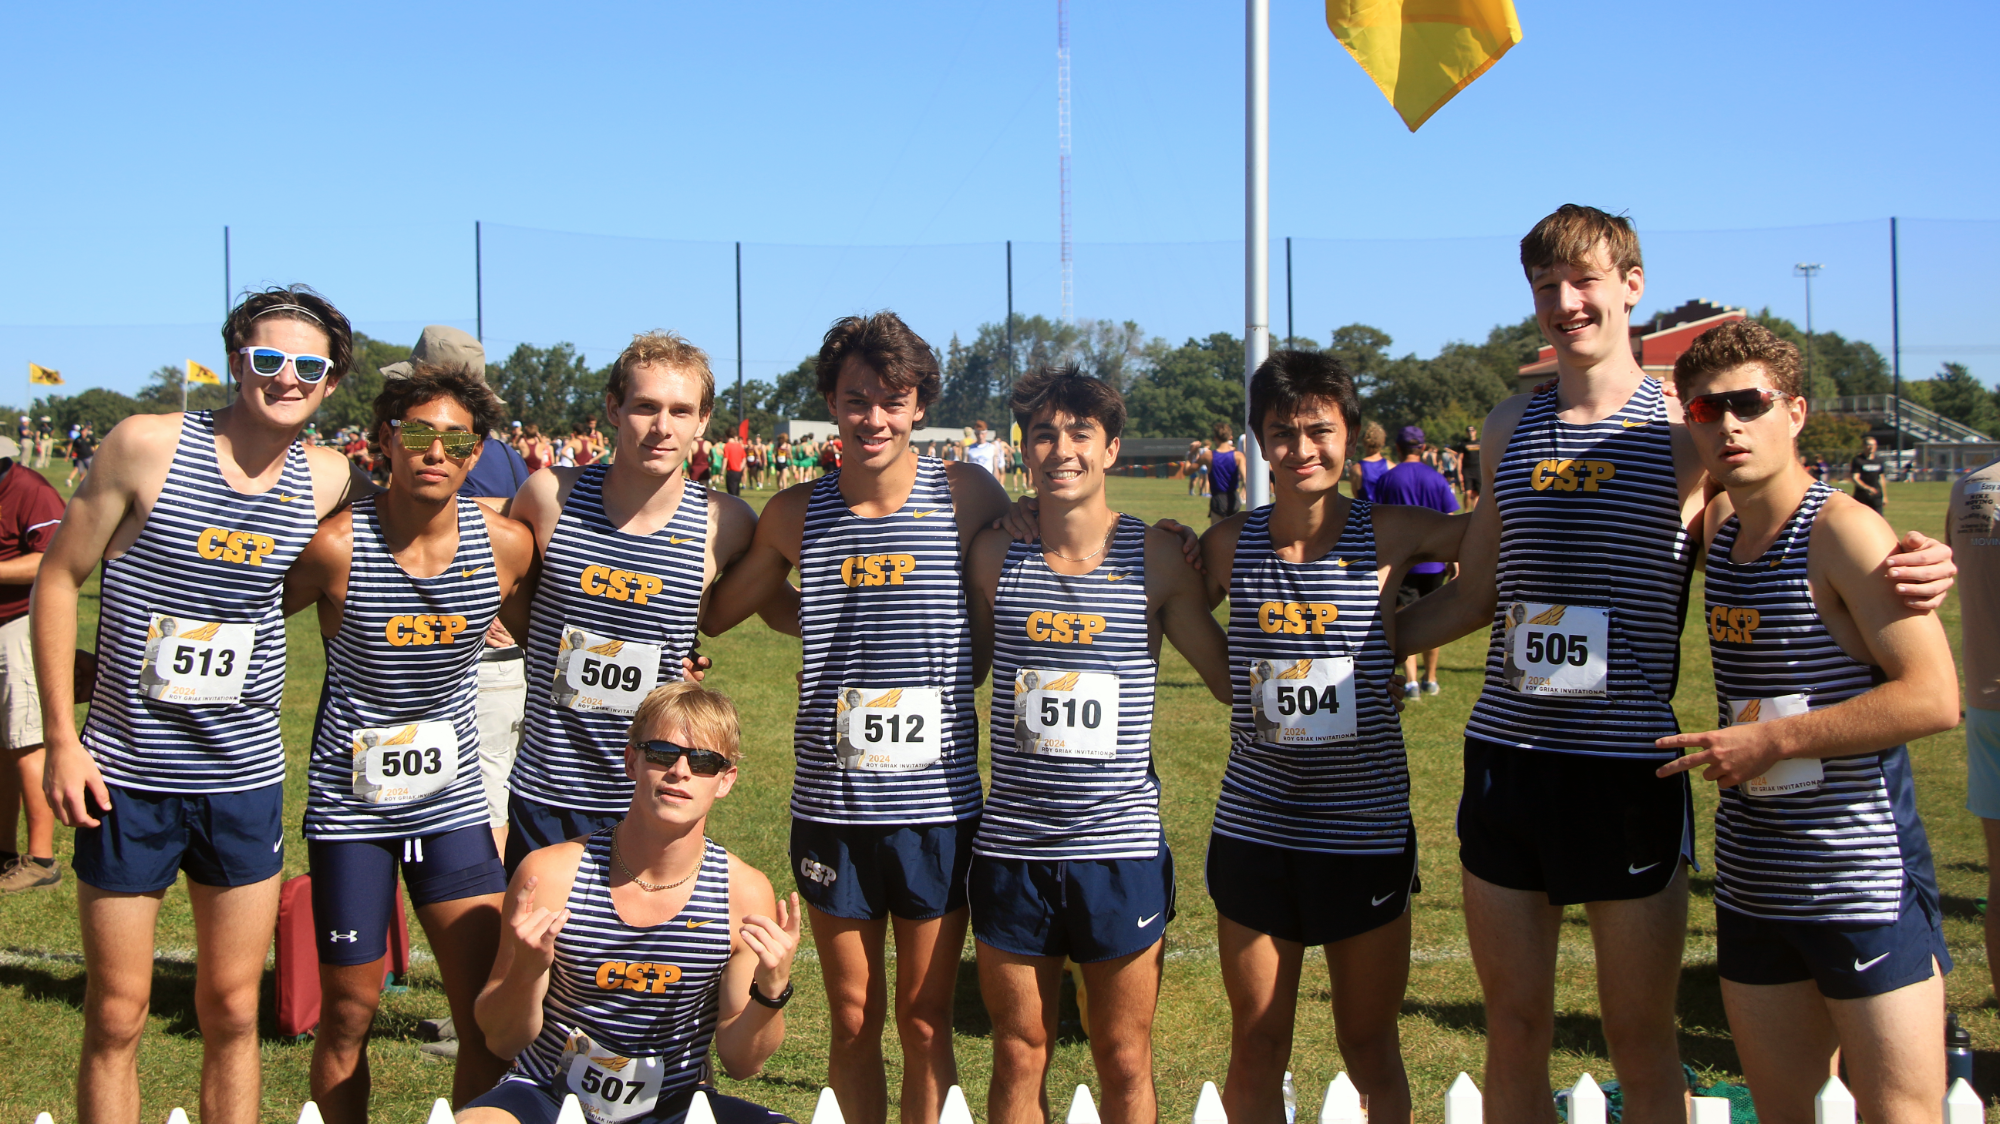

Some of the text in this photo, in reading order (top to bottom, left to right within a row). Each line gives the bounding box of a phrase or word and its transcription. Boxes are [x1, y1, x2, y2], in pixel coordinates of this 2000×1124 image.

[1531, 459, 1616, 492] CSP
[1981, 482, 1996, 491] Easy
[197, 528, 276, 567] CSP
[580, 565, 664, 605] CSP
[841, 554, 915, 588] CSP
[385, 615, 467, 646] CSP
[1026, 611, 1106, 644] CSP
[1259, 602, 1338, 634] CSP
[1711, 606, 1760, 644] CSP
[173, 645, 236, 677] 513
[1526, 631, 1588, 667] 505
[581, 658, 642, 692] 509
[1528, 676, 1551, 686] 2024
[172, 686, 196, 696] 2024
[581, 696, 603, 706] 2024
[1277, 685, 1340, 716] 504
[864, 714, 925, 743] 512
[1040, 697, 1102, 729] 510
[1044, 739, 1065, 748] 2024
[1284, 727, 1307, 736] 2024
[382, 747, 442, 777] 503
[868, 755, 890, 763] 2024
[386, 788, 409, 797] 2024
[801, 857, 837, 887] CSP
[596, 961, 682, 993] CSP
[581, 1065, 646, 1105] 507
